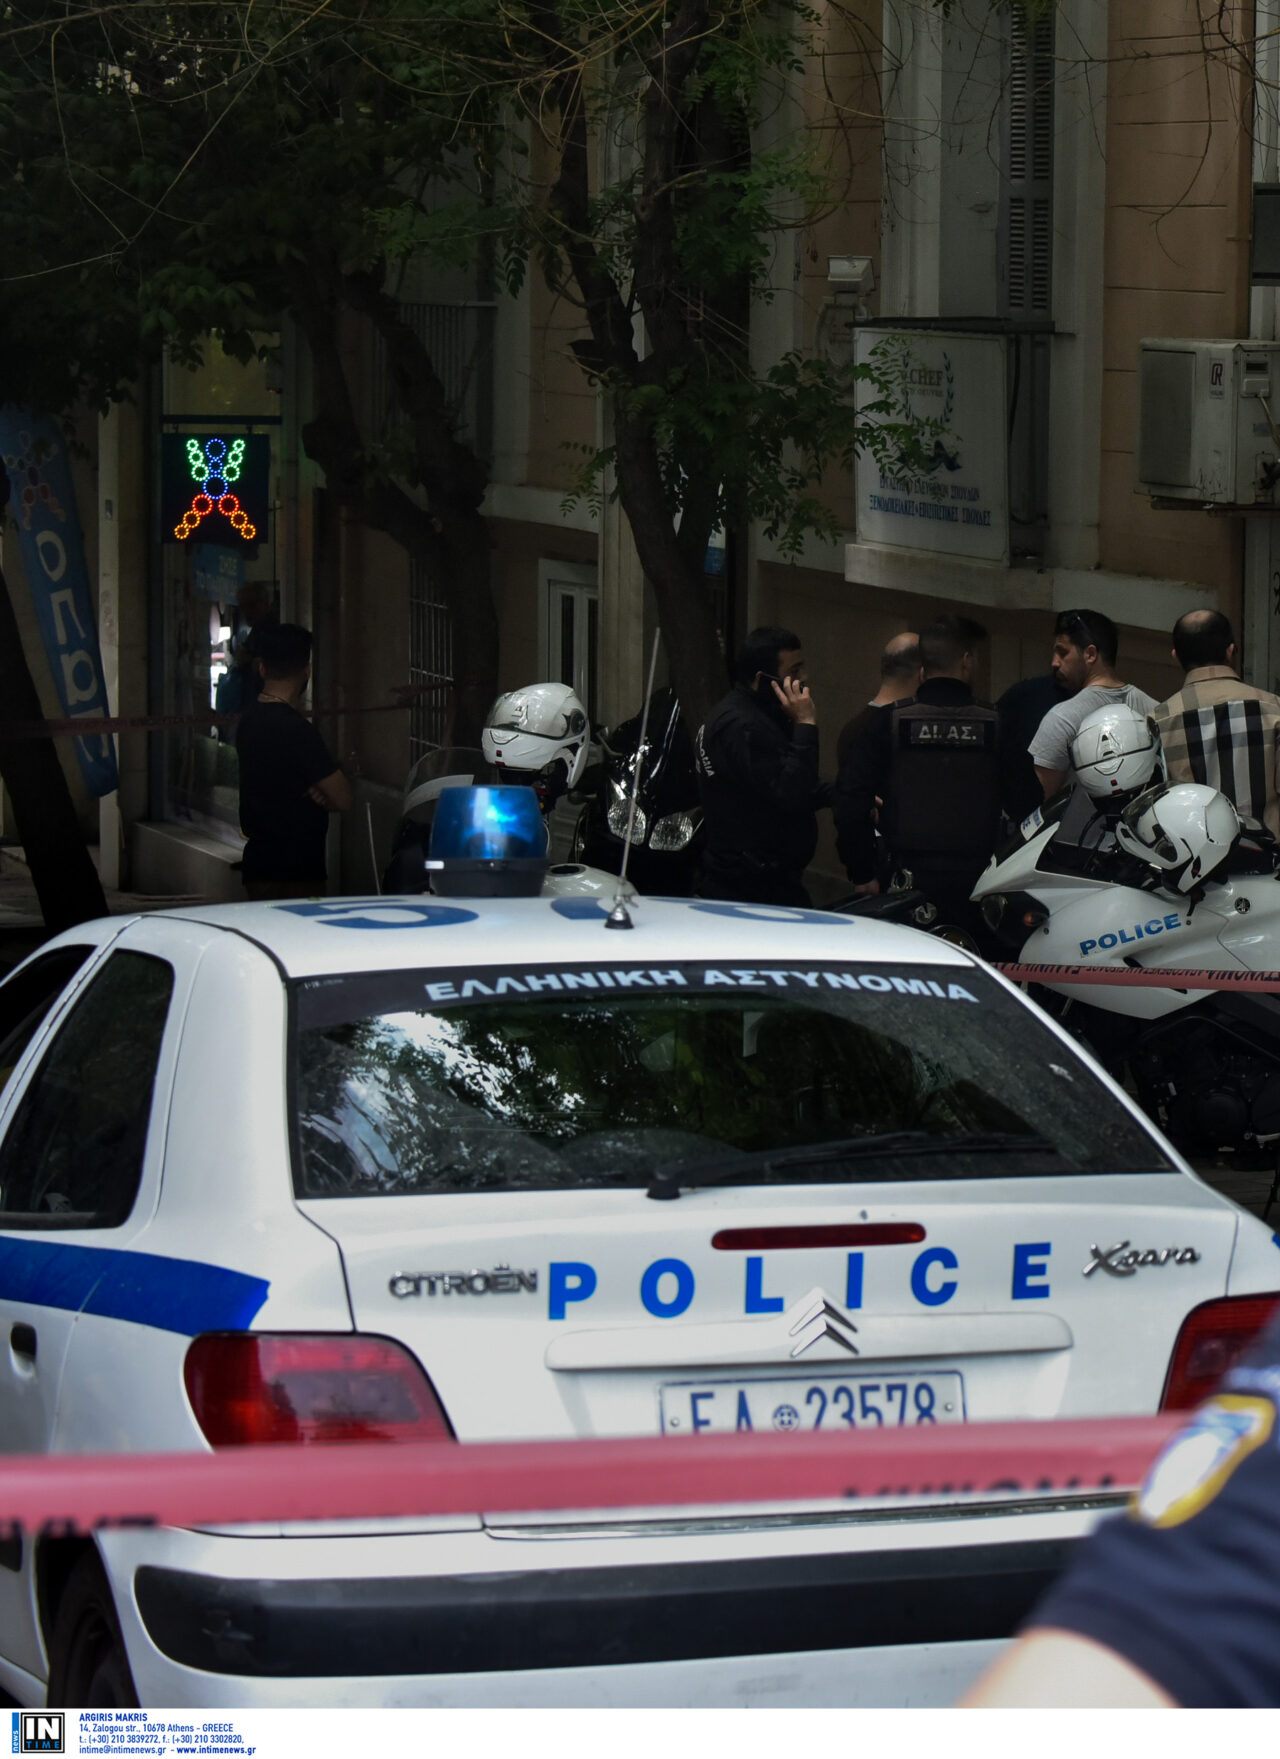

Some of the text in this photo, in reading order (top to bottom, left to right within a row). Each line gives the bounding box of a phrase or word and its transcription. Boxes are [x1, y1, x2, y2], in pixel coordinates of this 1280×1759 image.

[1079, 913, 1182, 956] POLICE
[425, 969, 980, 1003] ΕΛΛΗΝΙΚΗ ΑΣΤΥΝΟΜΙΑ
[388, 1242, 1052, 1321] CITROËN POLICE
[805, 1381, 938, 1432] 23578
